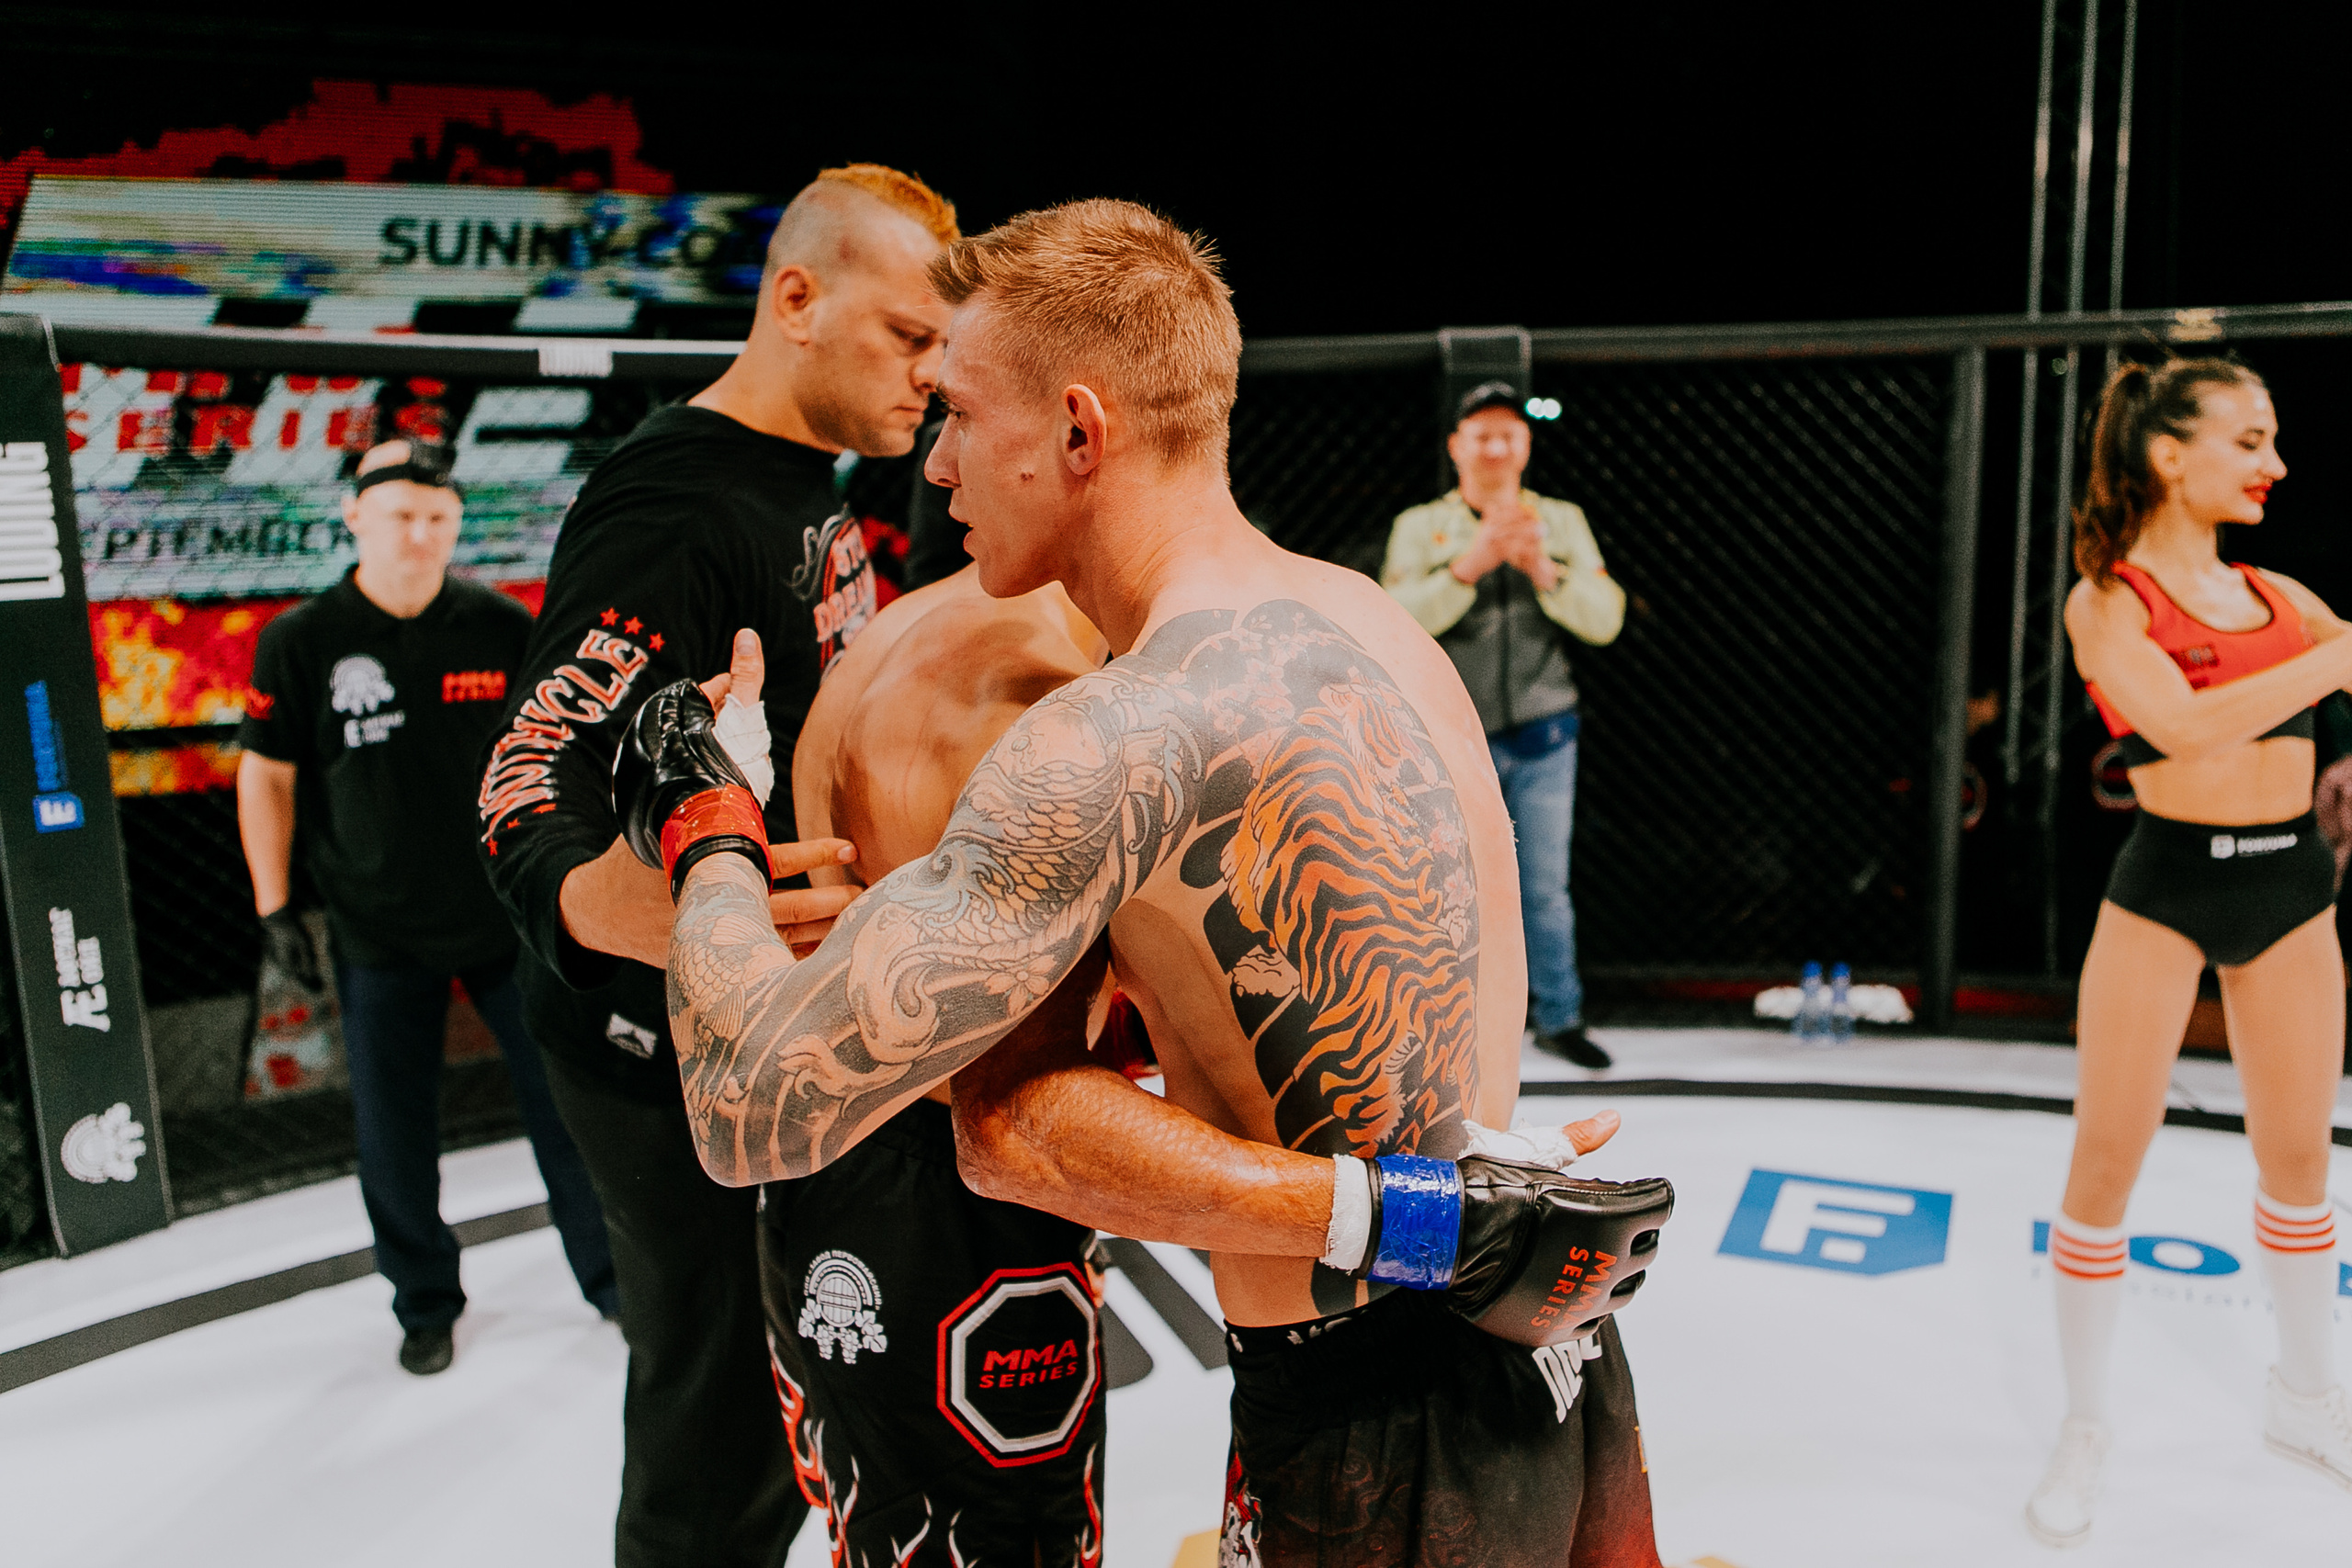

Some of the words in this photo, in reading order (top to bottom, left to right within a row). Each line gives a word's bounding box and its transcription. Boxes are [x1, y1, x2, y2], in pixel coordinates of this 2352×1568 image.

[1531, 1246, 1589, 1328] SERIES
[1552, 1250, 1618, 1331] MMA
[978, 1361, 1079, 1389] SERIES
[983, 1339, 1079, 1371] MMA
